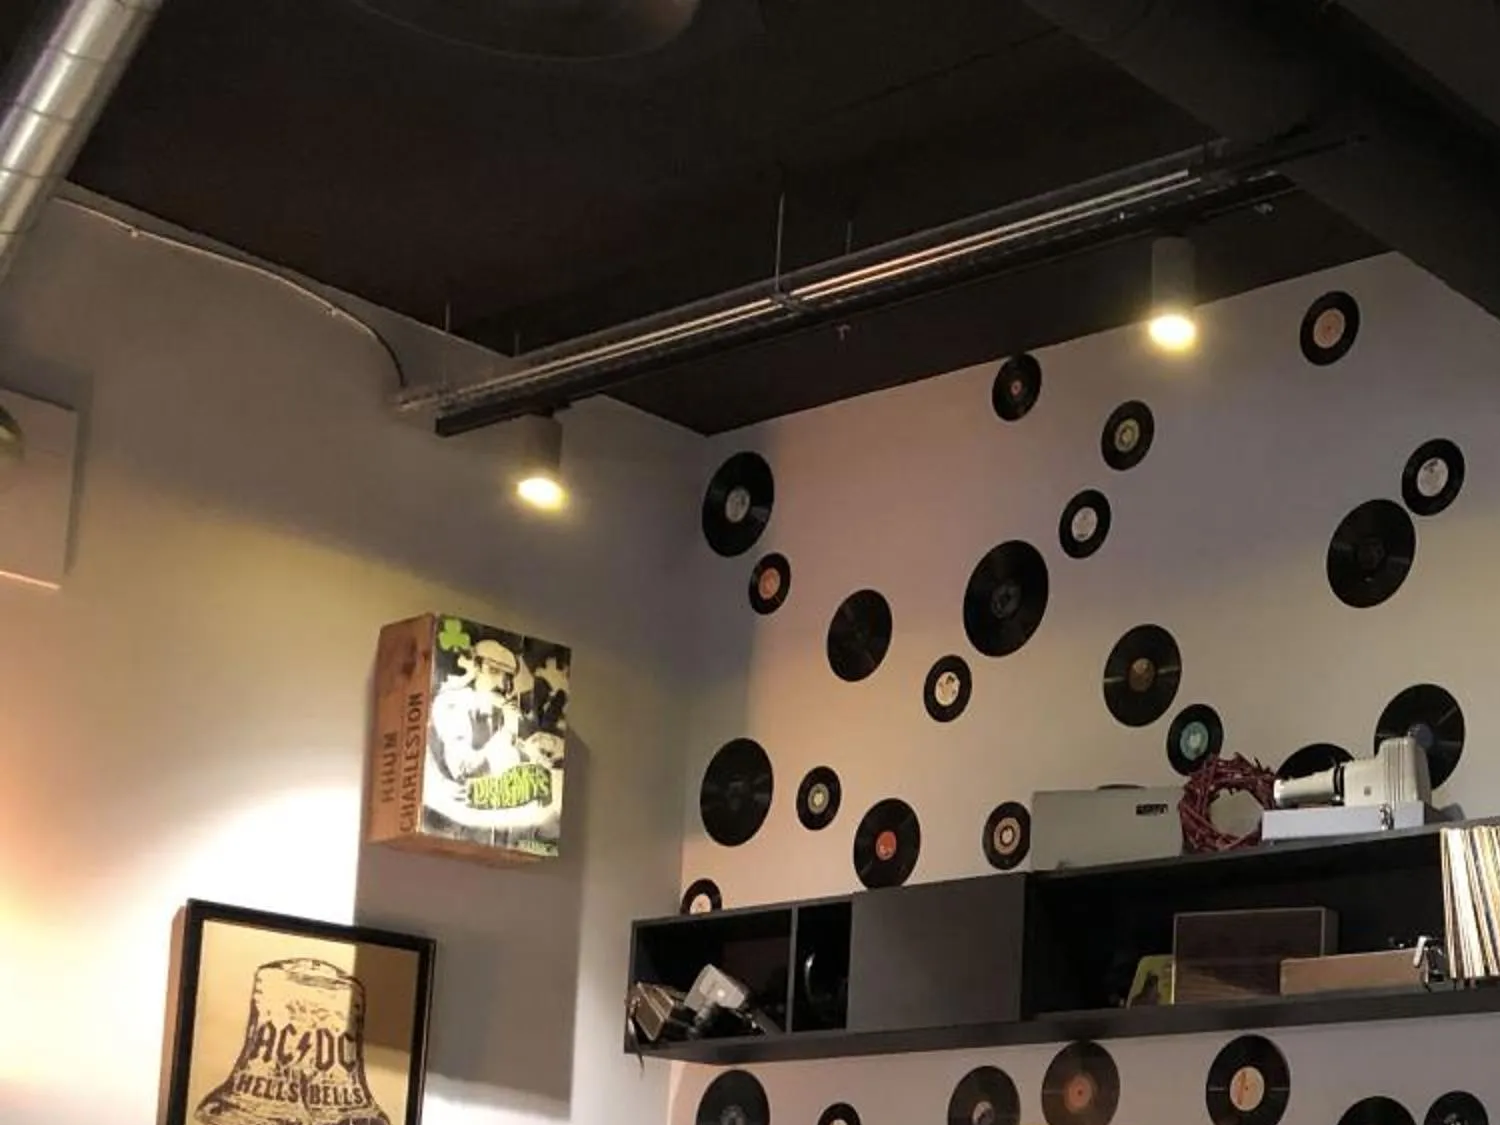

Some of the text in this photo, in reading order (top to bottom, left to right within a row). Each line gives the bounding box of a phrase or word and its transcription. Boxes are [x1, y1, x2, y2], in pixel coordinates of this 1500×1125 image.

[400, 692, 424, 833] CHARLESTON
[237, 1073, 364, 1106] HELLS BELLS
